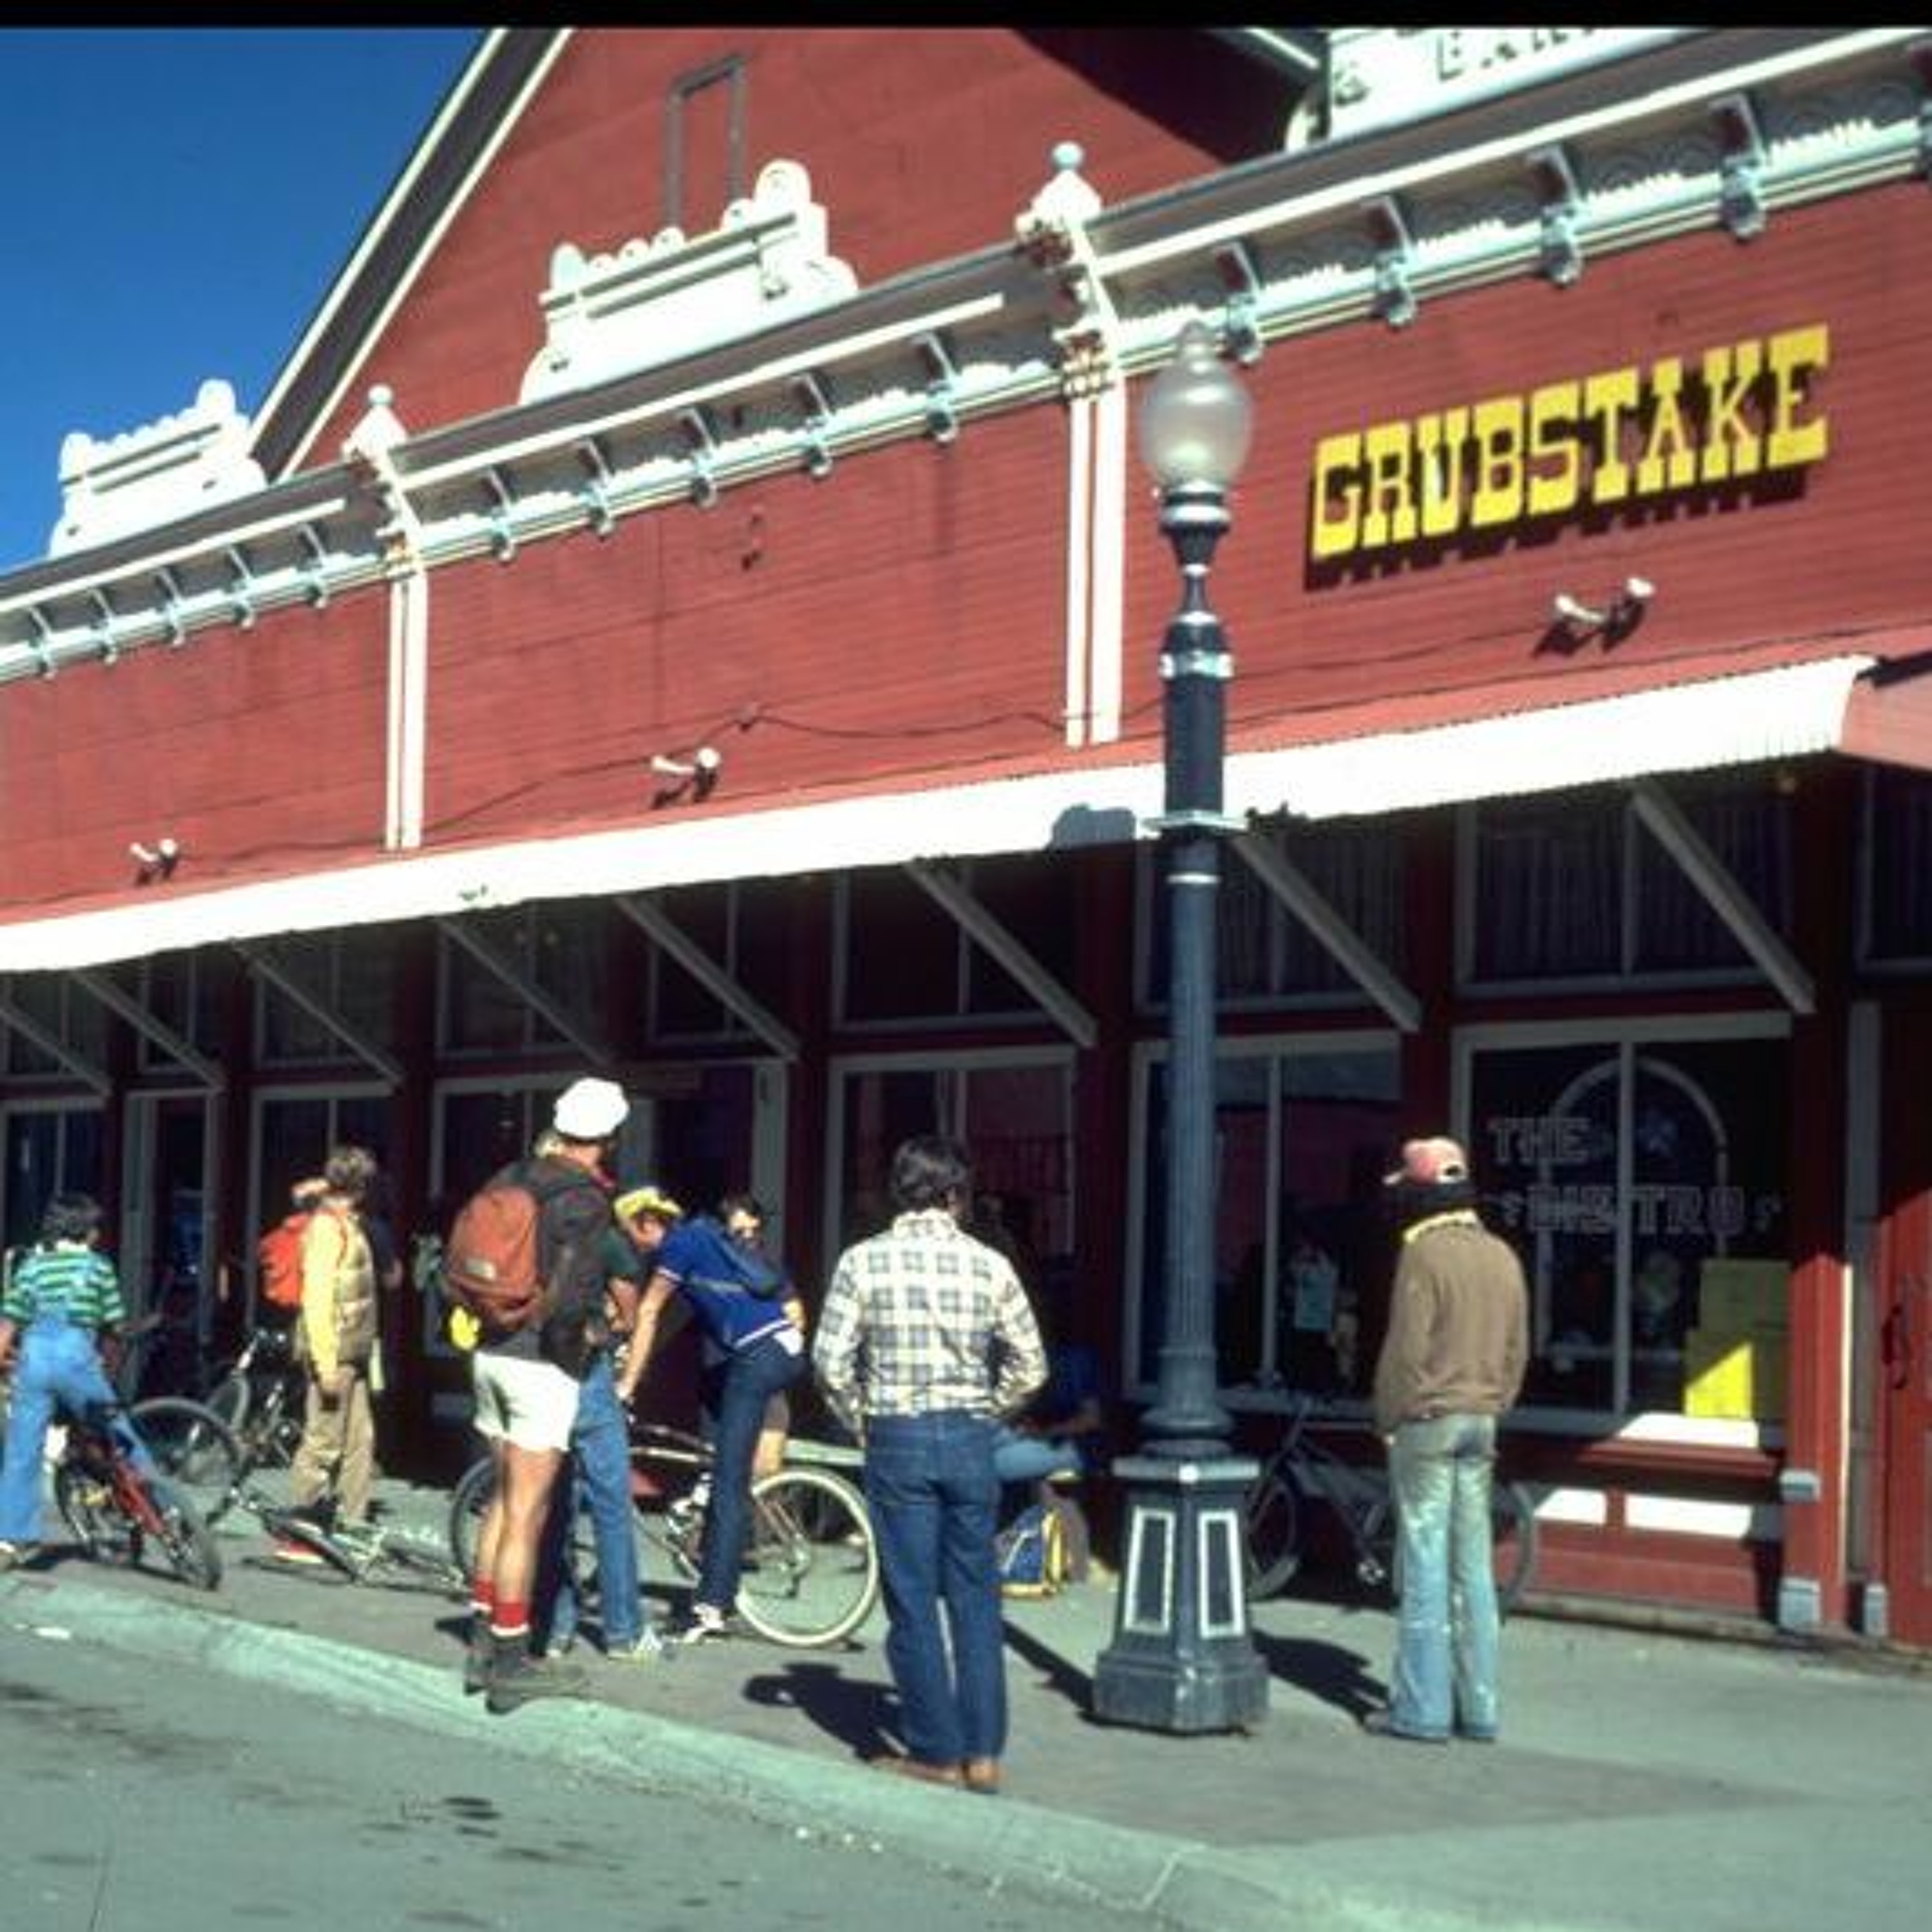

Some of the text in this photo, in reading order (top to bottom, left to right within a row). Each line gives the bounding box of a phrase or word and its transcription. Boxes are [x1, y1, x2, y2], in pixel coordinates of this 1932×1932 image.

[1312, 324, 1828, 558] GRUBSTAKE
[1490, 1116, 1591, 1164] THE
[1526, 1185, 1744, 1235] BISTRO
